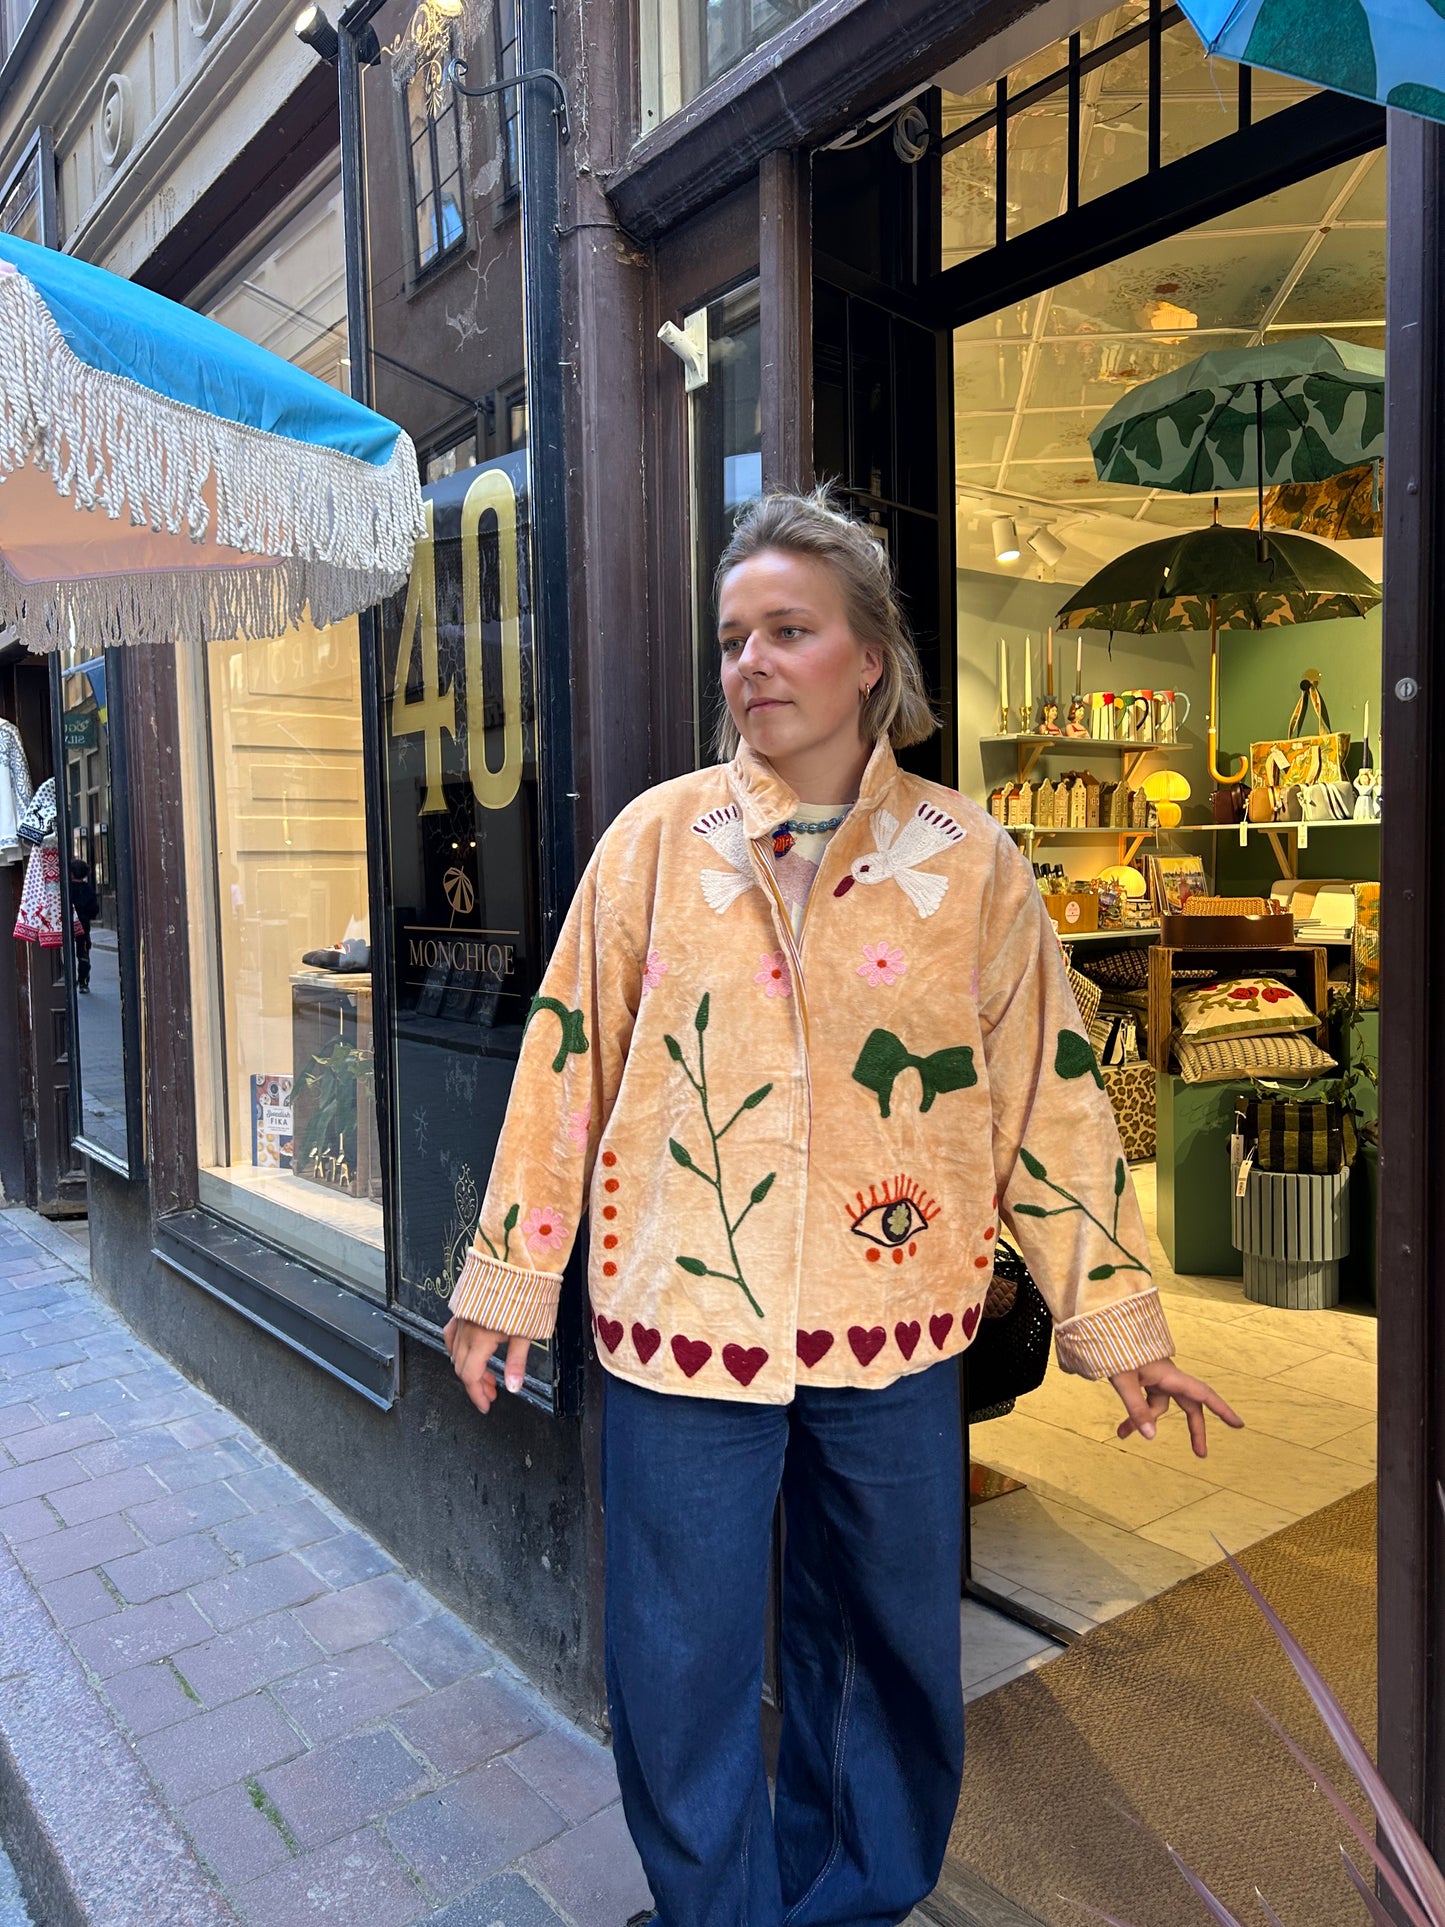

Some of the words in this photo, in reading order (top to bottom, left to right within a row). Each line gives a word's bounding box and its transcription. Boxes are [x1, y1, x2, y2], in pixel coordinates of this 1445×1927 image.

[392, 468, 524, 816] 40
[409, 939, 515, 981] MONCHIQE
[270, 1117, 289, 1126] FIKA
